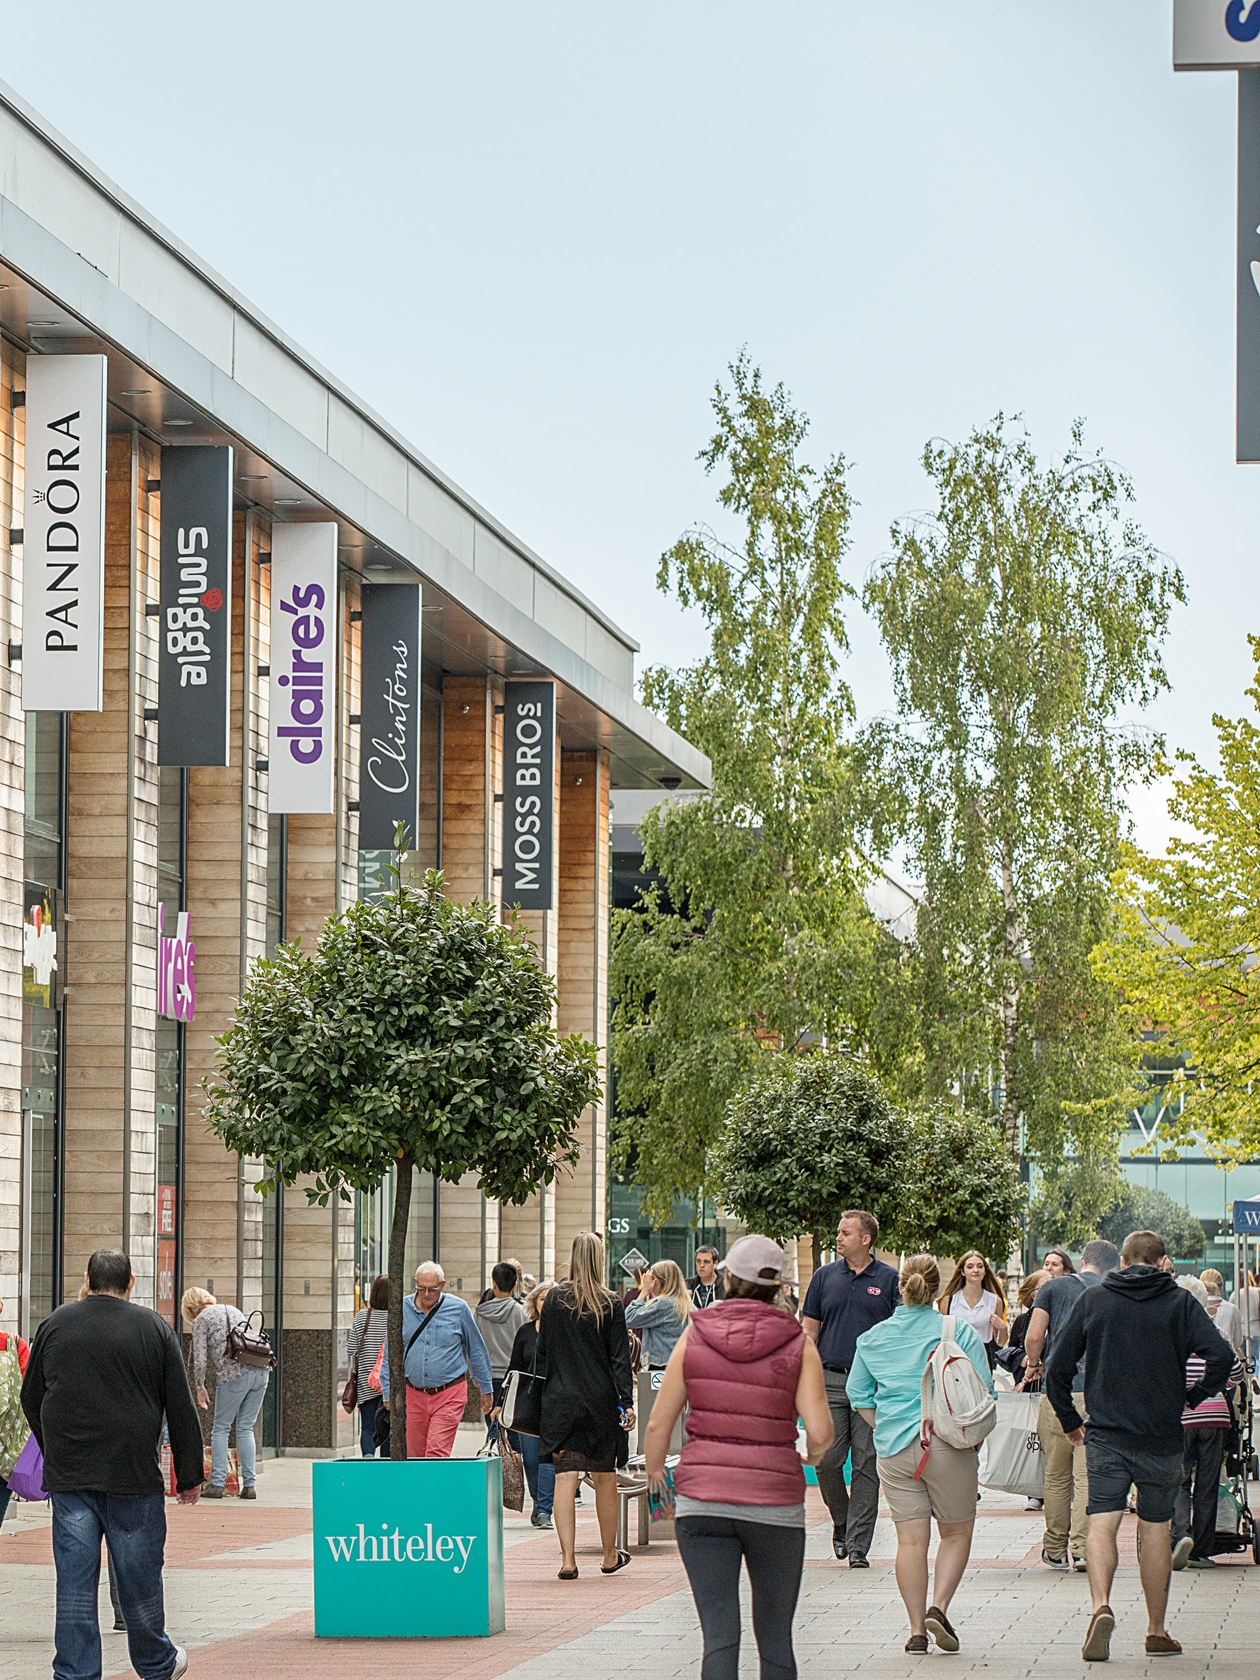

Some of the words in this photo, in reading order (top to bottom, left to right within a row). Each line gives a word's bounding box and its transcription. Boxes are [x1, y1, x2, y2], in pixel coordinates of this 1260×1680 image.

[45, 410, 81, 652] PANDORA
[166, 526, 211, 687] smiggle
[276, 582, 326, 764] claire's
[368, 639, 410, 794] Clintons
[515, 702, 542, 786] BROS
[514, 796, 541, 890] MOSS
[157, 901, 197, 1023] ire's
[324, 1522, 477, 1574] whiteley
